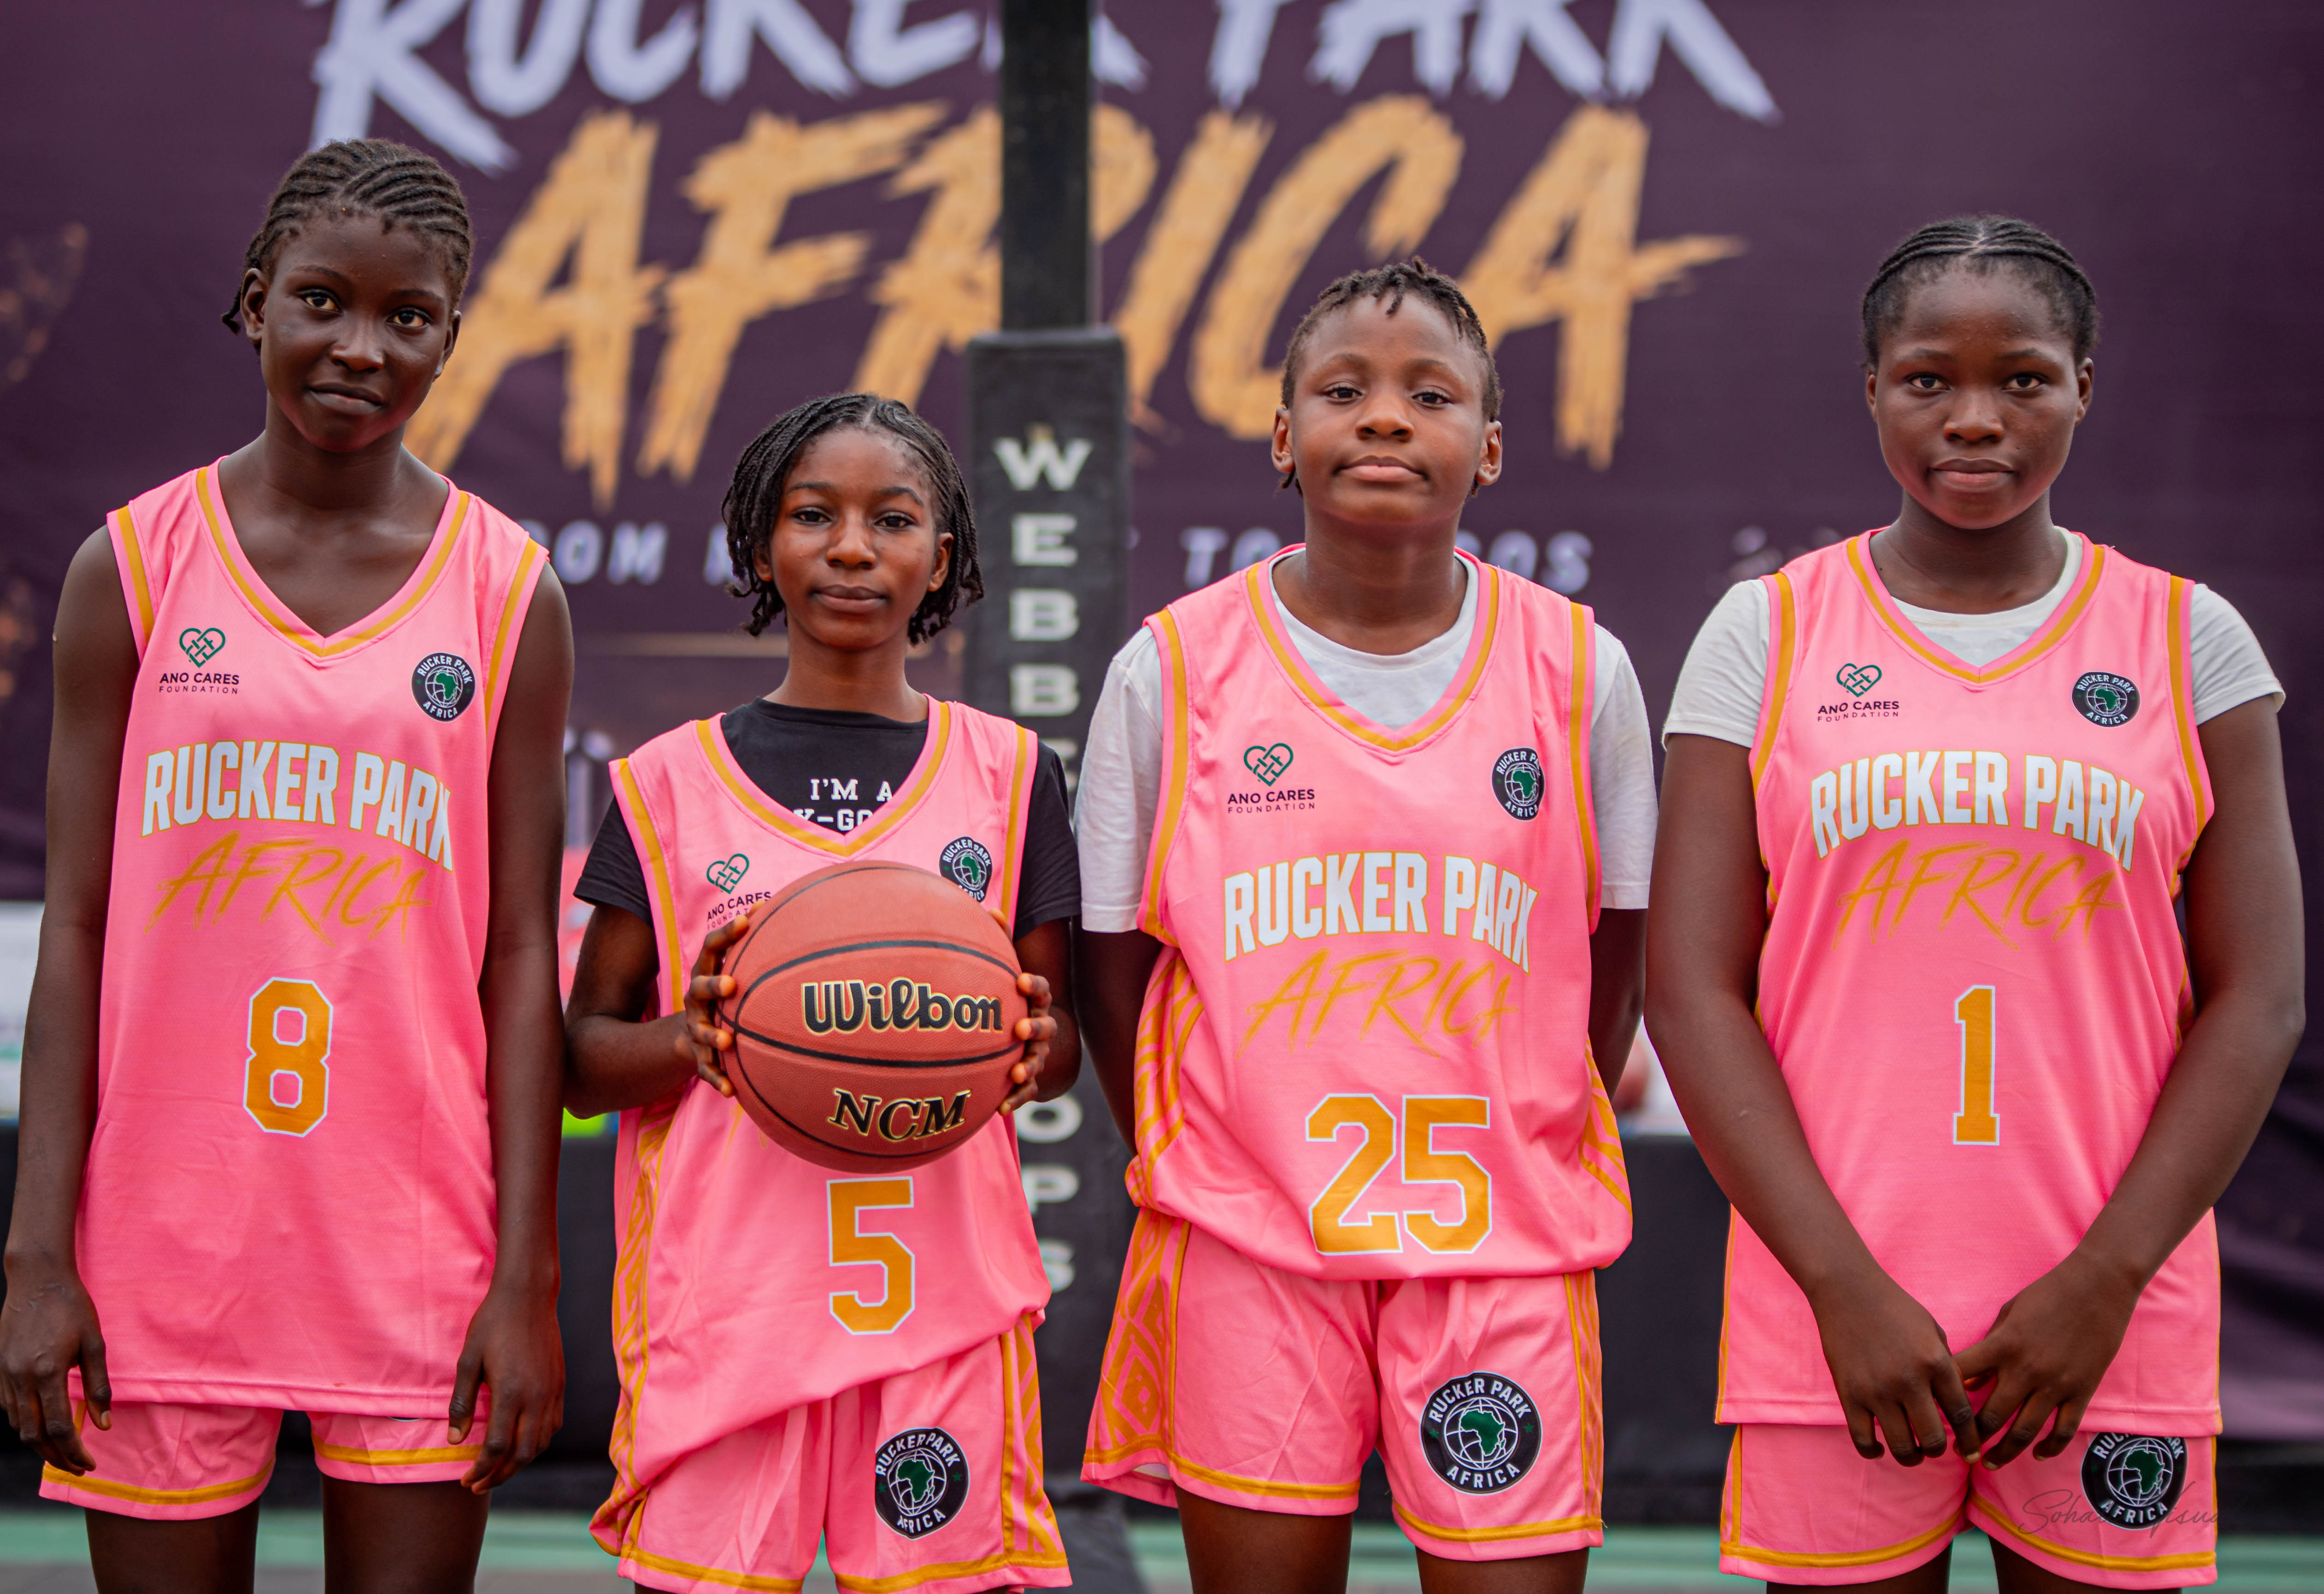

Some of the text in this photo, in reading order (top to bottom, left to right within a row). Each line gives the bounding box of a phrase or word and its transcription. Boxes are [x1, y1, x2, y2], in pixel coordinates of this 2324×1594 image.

[159, 672, 240, 685] ANO CARES
[417, 655, 473, 685] RUCKER PARK
[159, 686, 238, 695] FOUNDATION
[2076, 674, 2136, 694] RUCKER PARK
[423, 701, 458, 719] AFRICA
[1817, 711, 1899, 722] FOUNDATION
[1818, 701, 1900, 715] ANO CARES
[2086, 711, 2128, 725] AFRICA
[1496, 750, 1527, 774] RUCKER
[810, 778, 893, 802] I'M A
[1227, 789, 1315, 805] ANO CARES
[141, 739, 341, 838] RUCKER
[348, 750, 453, 872] PARK
[1228, 803, 1315, 814] FOUNDATION
[1505, 801, 1539, 817] AFRICA
[1810, 750, 2146, 874] RUCKER PARK
[941, 839, 991, 867] RUCKER PARK
[144, 830, 433, 949] AFRICA
[1832, 837, 2125, 951] AFRICA
[707, 891, 772, 922] ANO CARES
[1224, 851, 1540, 976] RUCKER PARK
[1236, 947, 1519, 1060] AFRICA
[243, 976, 334, 1138] 8
[1953, 985, 2000, 1146] 1
[1305, 1092, 1493, 1256] 25
[826, 1176, 915, 1336] 5
[1429, 1377, 1532, 1424] RUCKER PARK
[875, 1432, 961, 1477] RUCKER PARK
[1446, 1463, 1521, 1489] AFRICA
[896, 1508, 947, 1534] AFRICA
[2100, 1500, 2168, 1524] AFRICA
